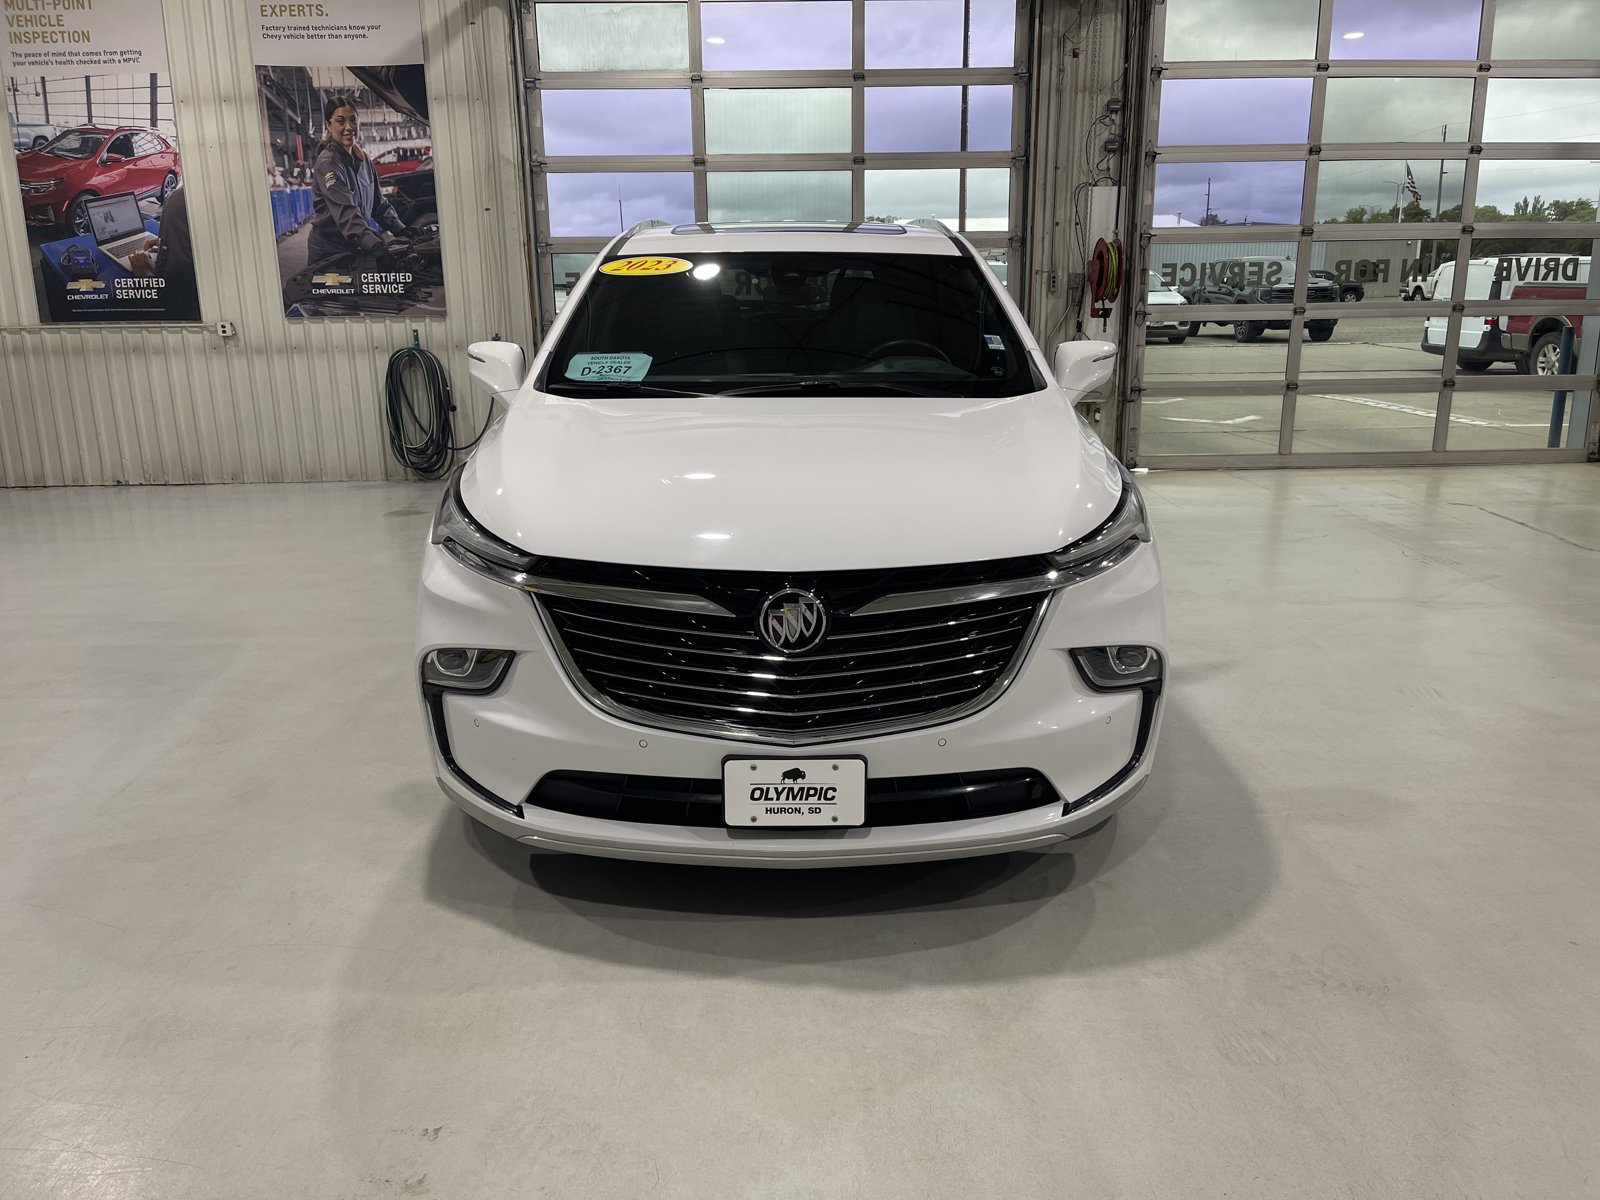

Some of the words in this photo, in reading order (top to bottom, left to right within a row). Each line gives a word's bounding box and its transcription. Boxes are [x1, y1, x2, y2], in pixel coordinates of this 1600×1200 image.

[4, 0, 92, 11] MULTI-POINT
[260, 4, 328, 17] EXPERTS.
[5, 14, 64, 27] VEHICLE
[9, 30, 91, 44] INSPECTION
[120, 49, 142, 57] getting
[612, 260, 678, 272] 2023
[114, 278, 166, 288] CERTIFIED
[361, 272, 412, 283] CERTIFIED
[116, 289, 158, 299] SERVICE
[362, 284, 404, 294] SERVICE
[67, 293, 109, 301] CHEVROLET
[580, 365, 632, 377] D-2367
[750, 787, 837, 801] OLYMPIC
[765, 807, 804, 816] HURON,
